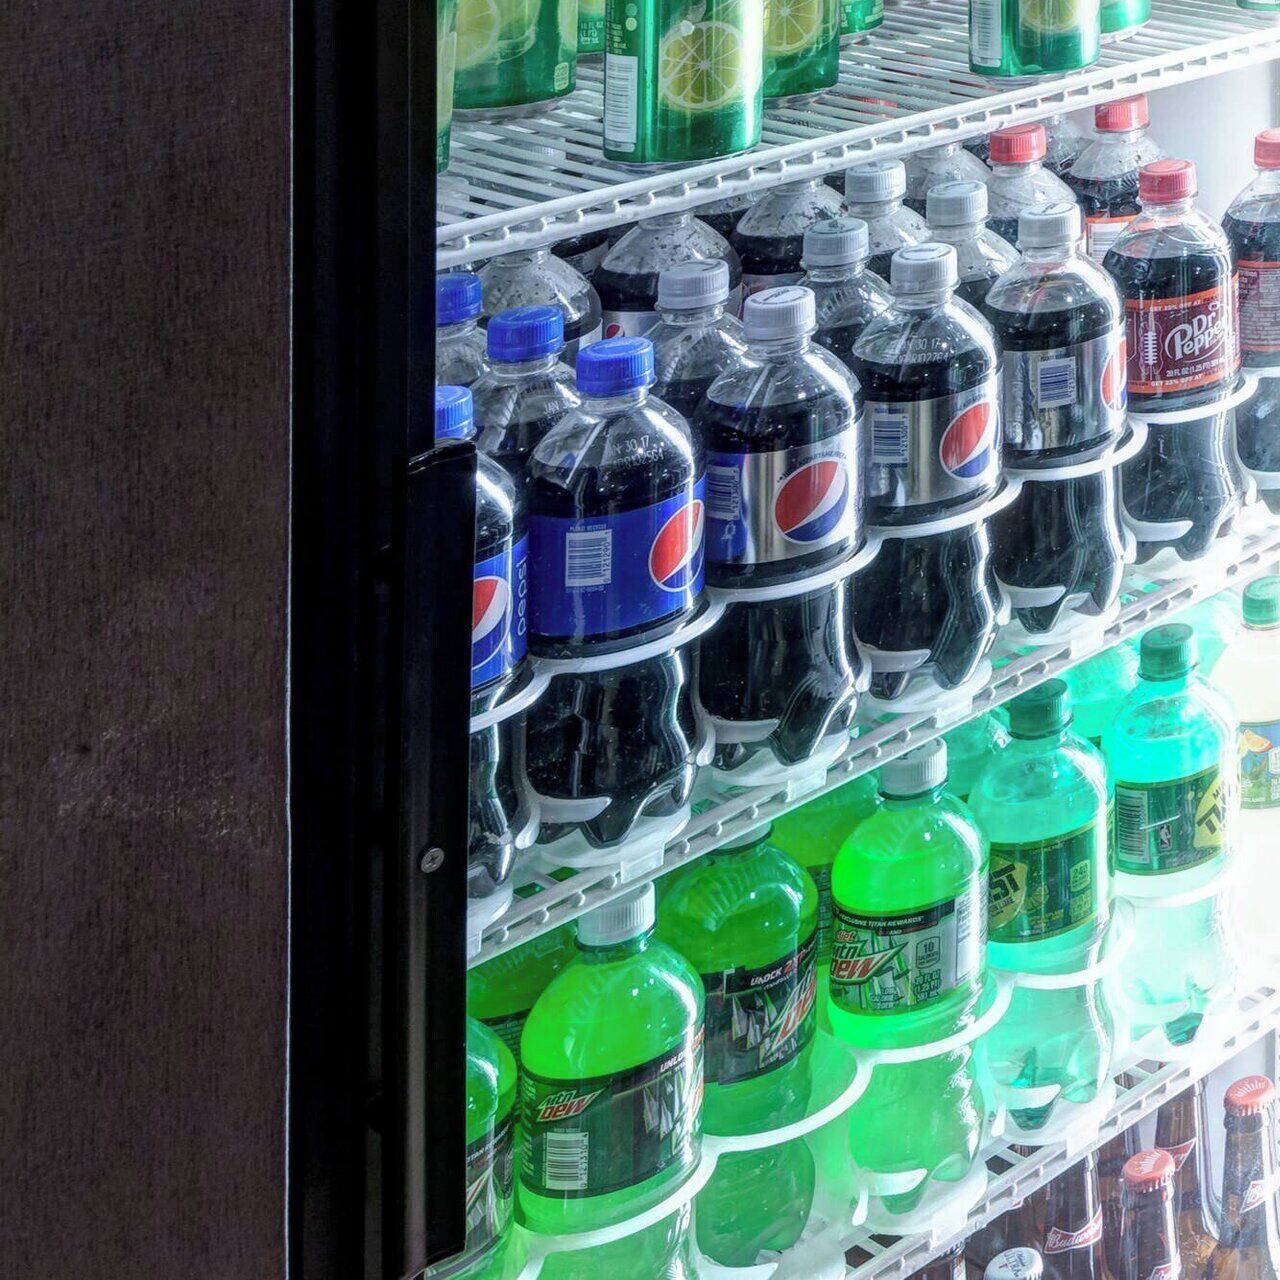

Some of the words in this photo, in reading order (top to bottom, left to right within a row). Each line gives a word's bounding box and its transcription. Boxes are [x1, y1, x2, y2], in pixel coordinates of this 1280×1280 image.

[1192, 312, 1217, 335] Dr
[515, 562, 529, 638] pepsi
[923, 942, 935, 953] 10
